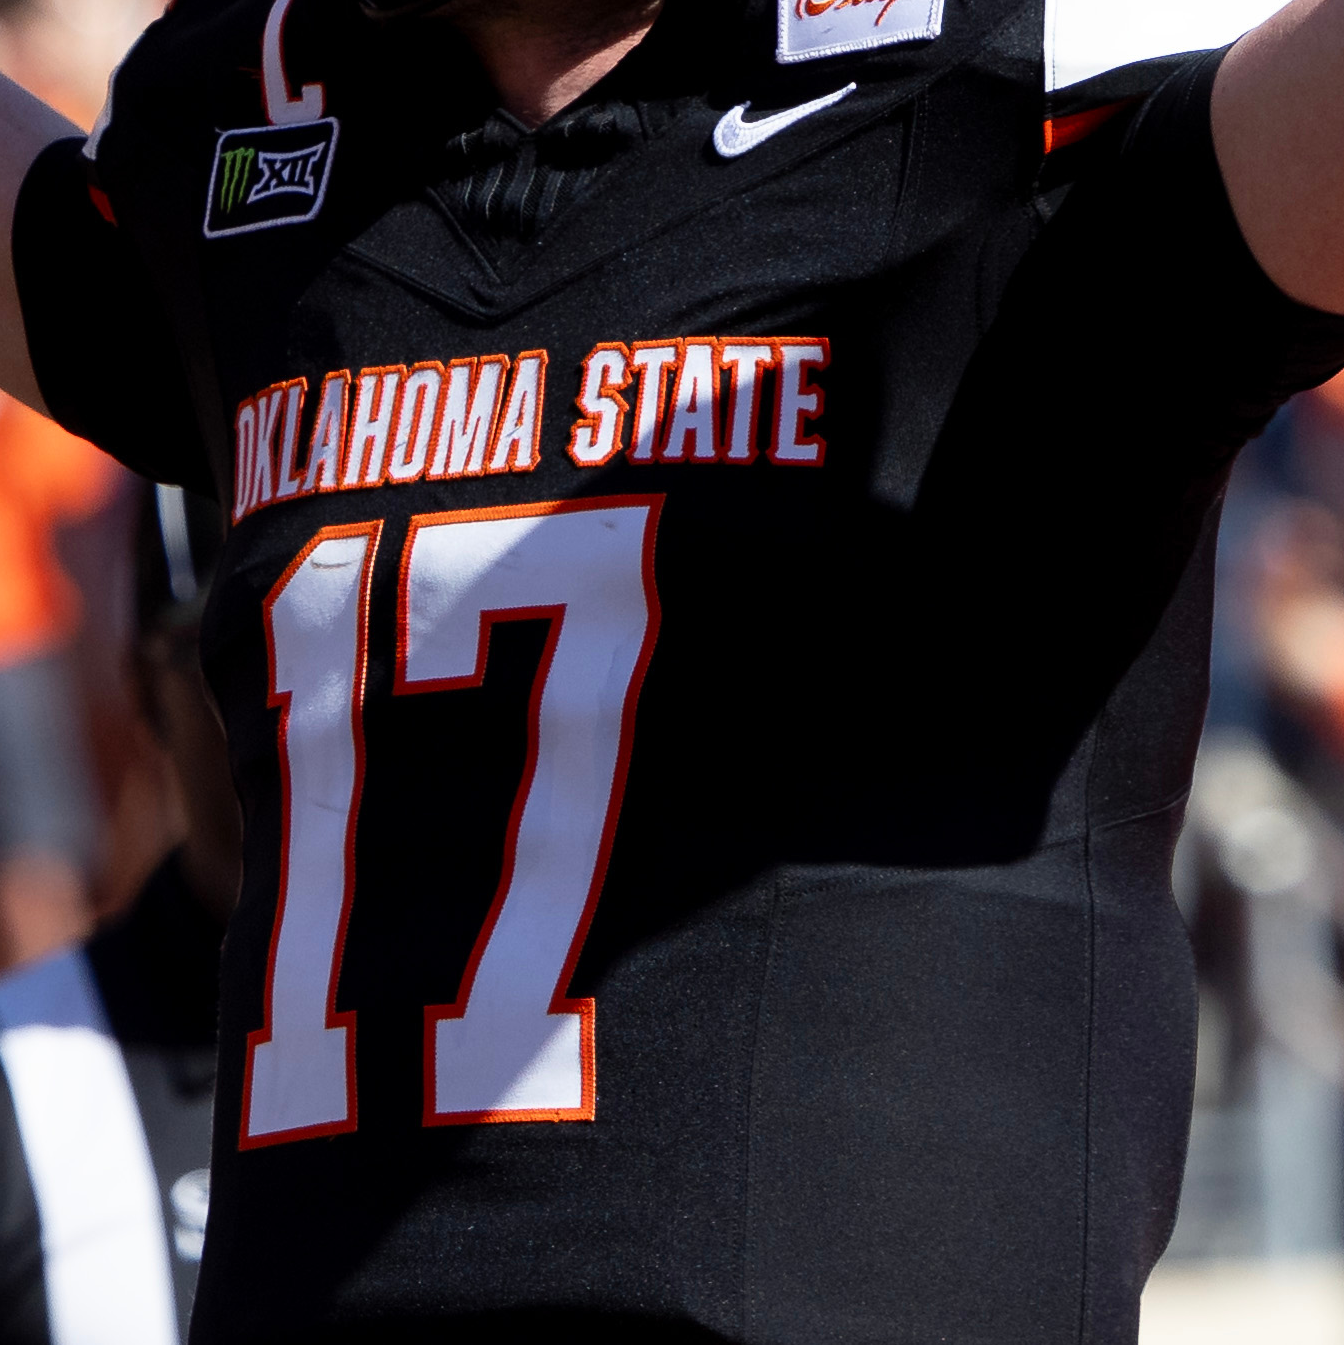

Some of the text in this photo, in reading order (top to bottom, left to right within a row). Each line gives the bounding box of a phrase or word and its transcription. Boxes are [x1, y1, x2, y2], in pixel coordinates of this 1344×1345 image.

[232, 337, 831, 525] OKLAHOMA STATE
[238, 493, 666, 1151] 17
